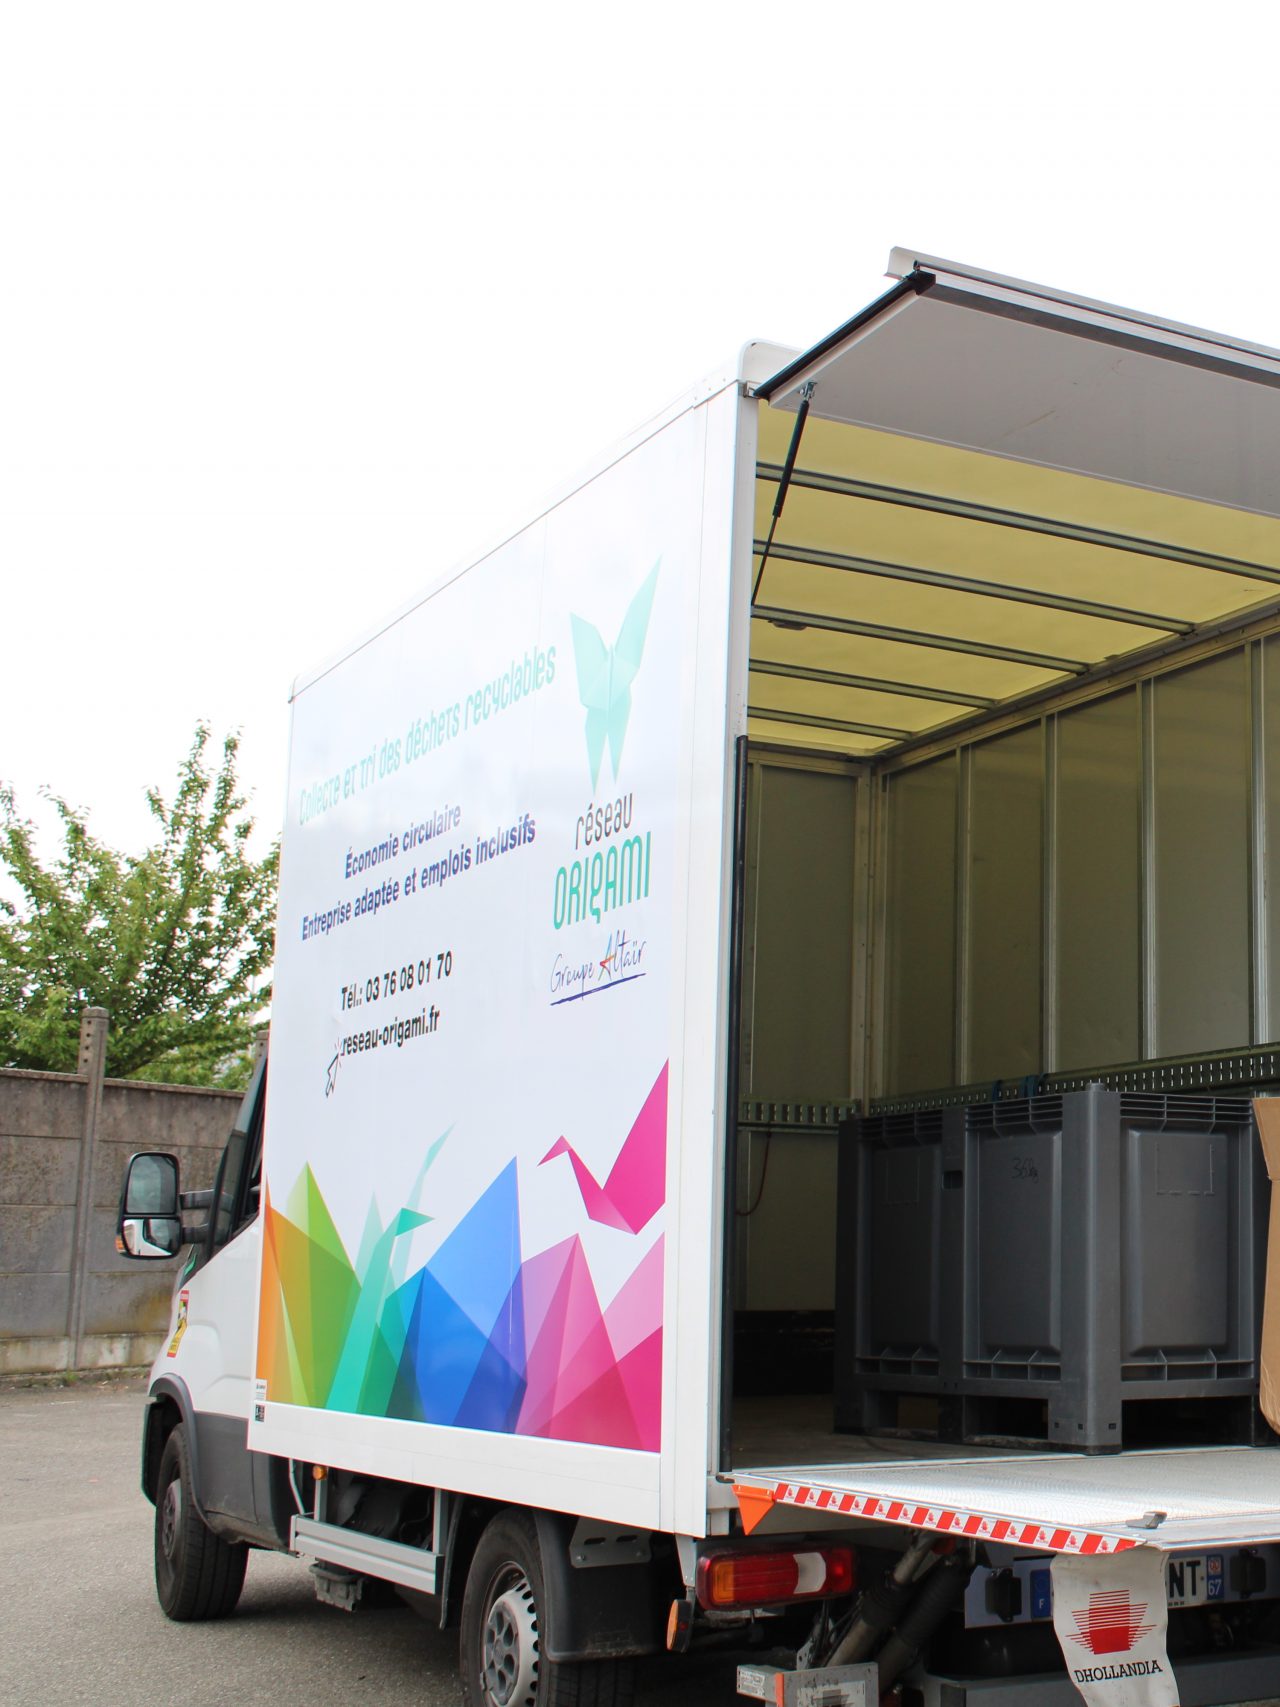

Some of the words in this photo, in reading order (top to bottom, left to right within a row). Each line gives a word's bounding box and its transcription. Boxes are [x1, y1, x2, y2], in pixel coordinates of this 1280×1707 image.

[299, 769, 341, 826] Collecte
[342, 764, 357, 799] et
[359, 744, 377, 789] tri
[379, 737, 402, 780] des
[405, 701, 461, 765] déchets
[464, 645, 557, 731] recyclables
[345, 831, 400, 880] Économie
[402, 803, 462, 853] circulaire
[575, 792, 633, 850] réseau
[302, 900, 352, 941] Entreprise
[354, 877, 400, 919] adaptée
[404, 871, 418, 896] et
[421, 842, 472, 889] emplois
[475, 812, 537, 867] inclusifs
[553, 831, 652, 931] ORIGAMI
[365, 976, 380, 1004] 03
[383, 970, 398, 998] 76
[400, 963, 415, 991] 08
[418, 957, 432, 985] 01
[437, 950, 453, 981] 70
[550, 953, 595, 1001] Groupe
[598, 929, 648, 982] Altaïr
[342, 1004, 441, 1059] reseau-origami.fr
[1208, 1579, 1221, 1596] 67
[1074, 1660, 1163, 1683] DHOLLANDIA
